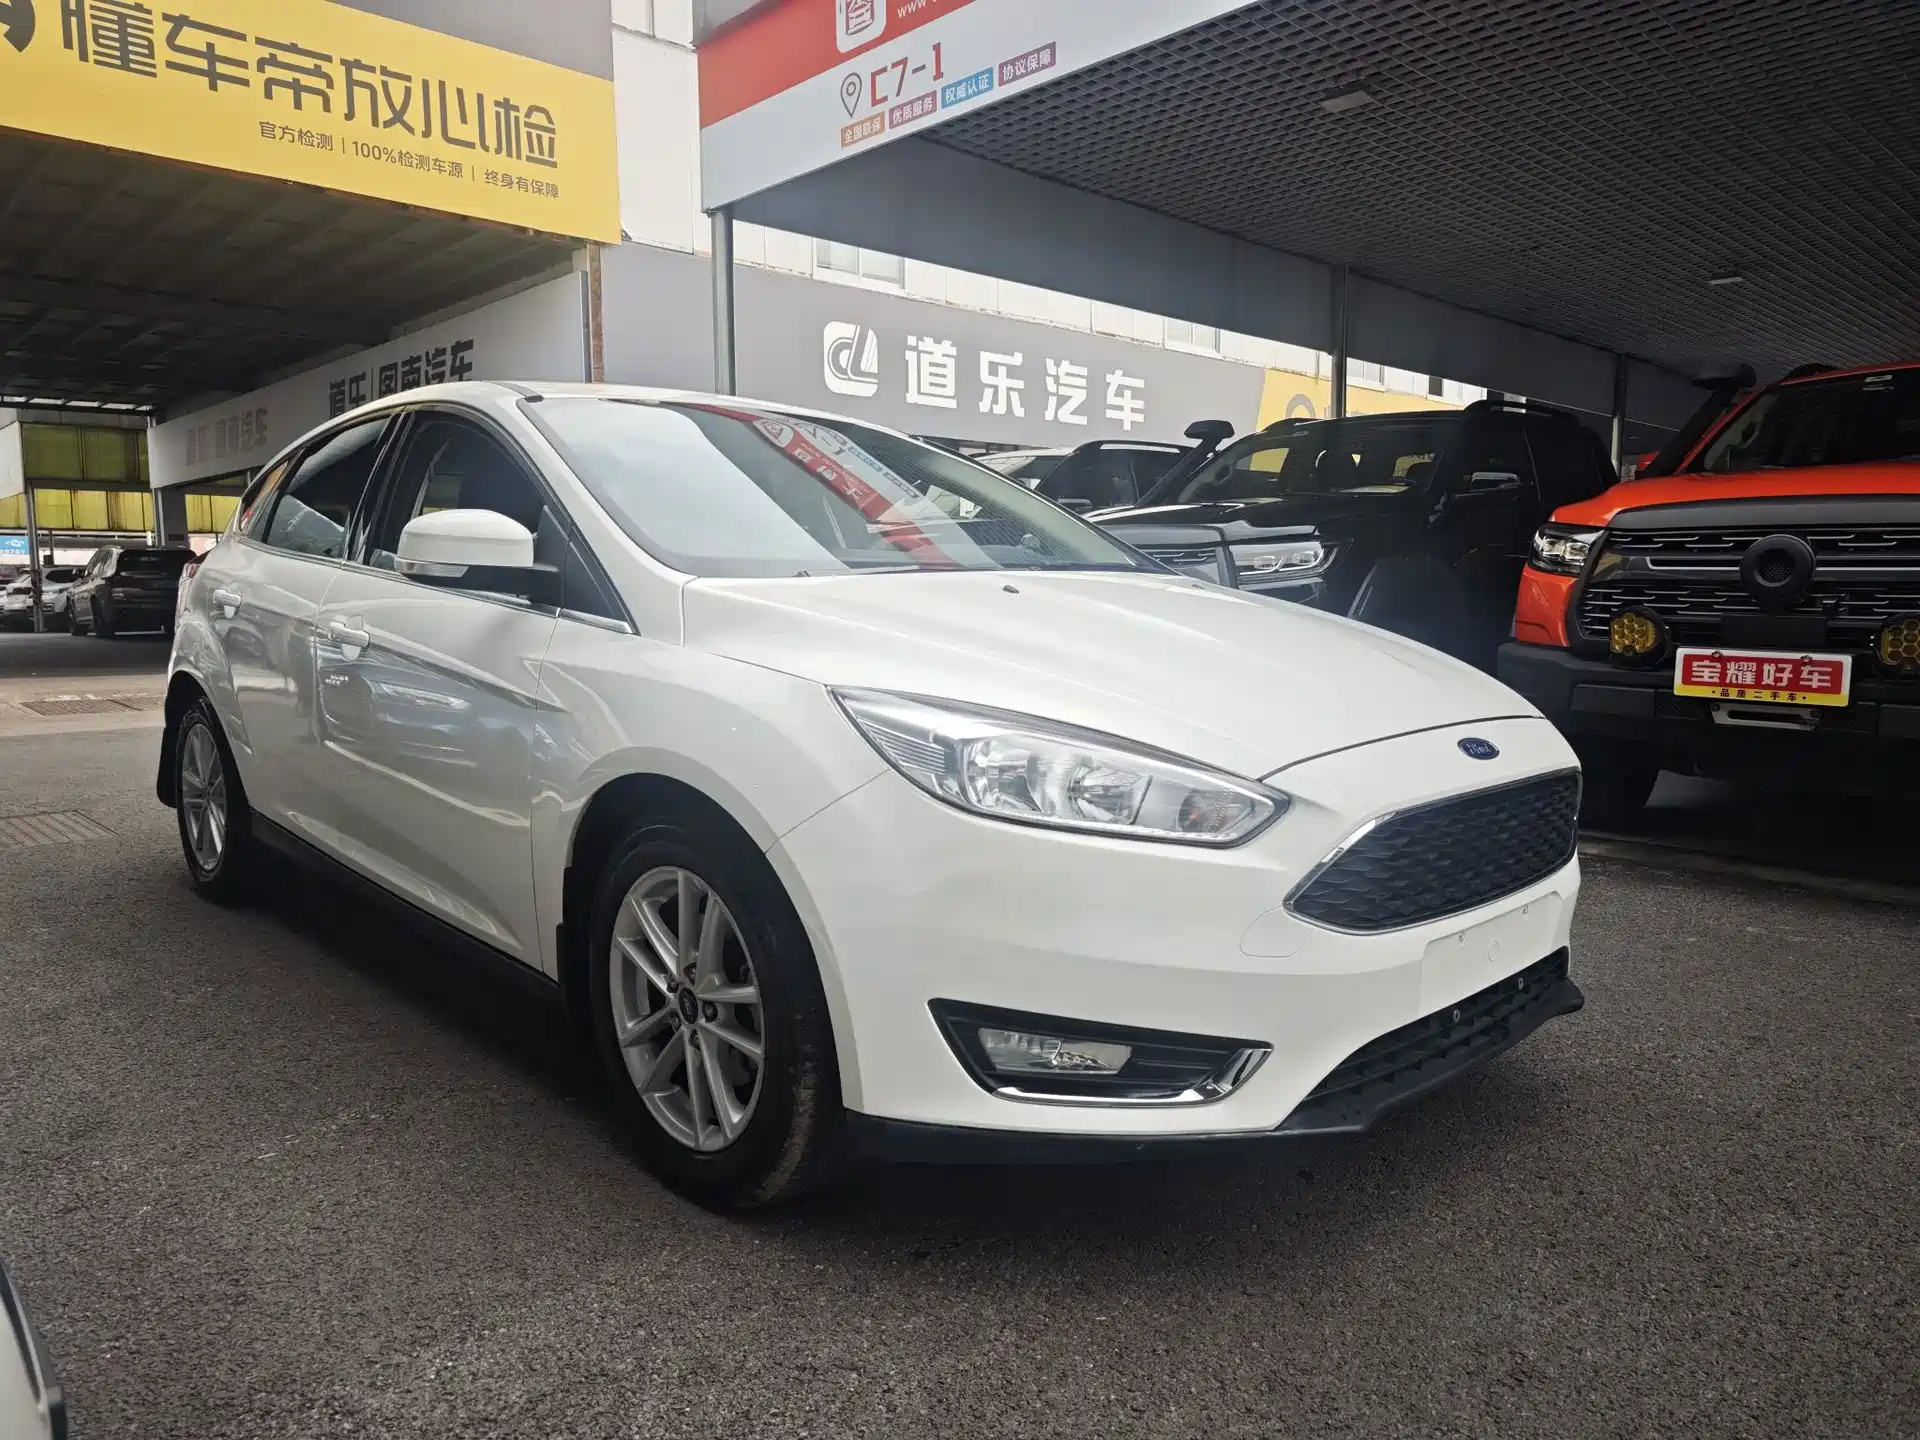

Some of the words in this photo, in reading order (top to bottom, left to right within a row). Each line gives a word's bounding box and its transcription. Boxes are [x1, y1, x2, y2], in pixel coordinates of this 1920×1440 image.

[61, 0, 558, 169] 懂车帝放心检
[844, 117, 882, 144] 全国联保
[892, 96, 933, 125] 优质服务
[945, 74, 989, 104] 权威认证
[1002, 48, 1051, 82] 协议保障
[870, 42, 944, 107] C7-1
[259, 121, 334, 152] 官方检测
[351, 140, 464, 179] 100%检测车源
[484, 168, 560, 200] 终身有保障
[904, 334, 1146, 431] 道乐汽车
[1690, 660, 1833, 689] 宝耀好车
[1720, 688, 1797, 702] 品质二手车
